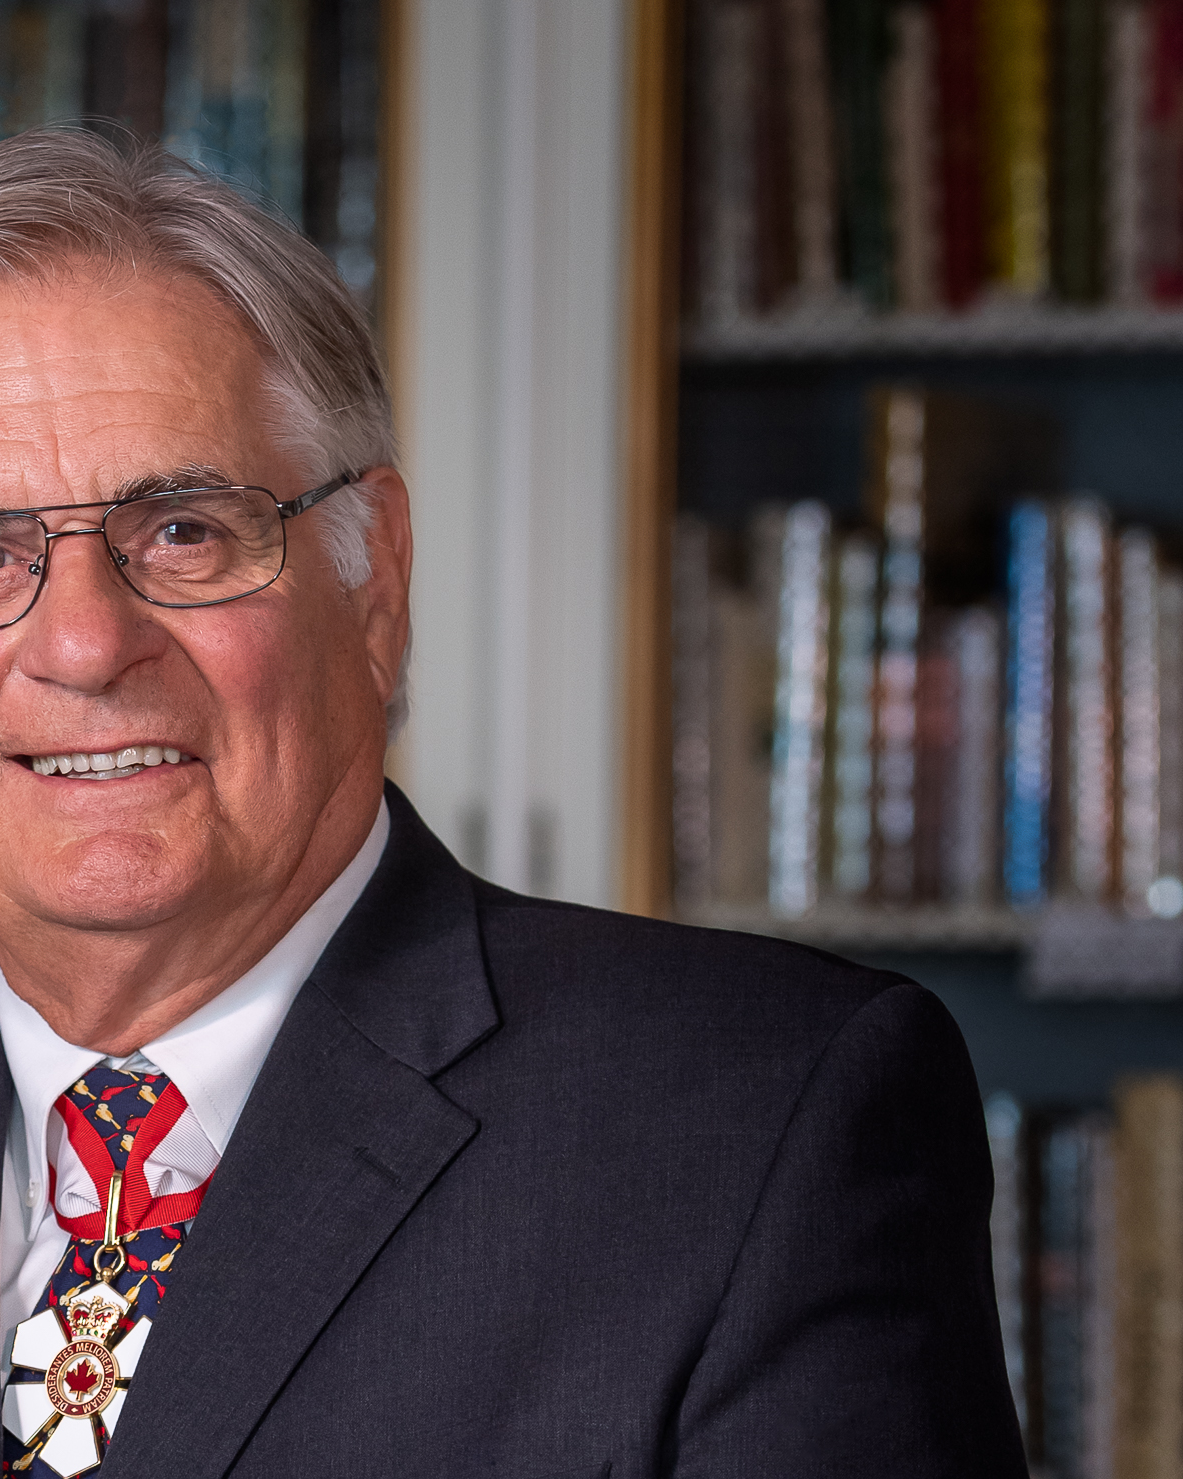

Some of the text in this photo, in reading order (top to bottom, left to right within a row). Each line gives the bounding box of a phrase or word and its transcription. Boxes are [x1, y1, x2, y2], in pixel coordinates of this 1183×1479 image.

[48, 1342, 113, 1413] DESIDERANTES MELIOREM PATRIAM
